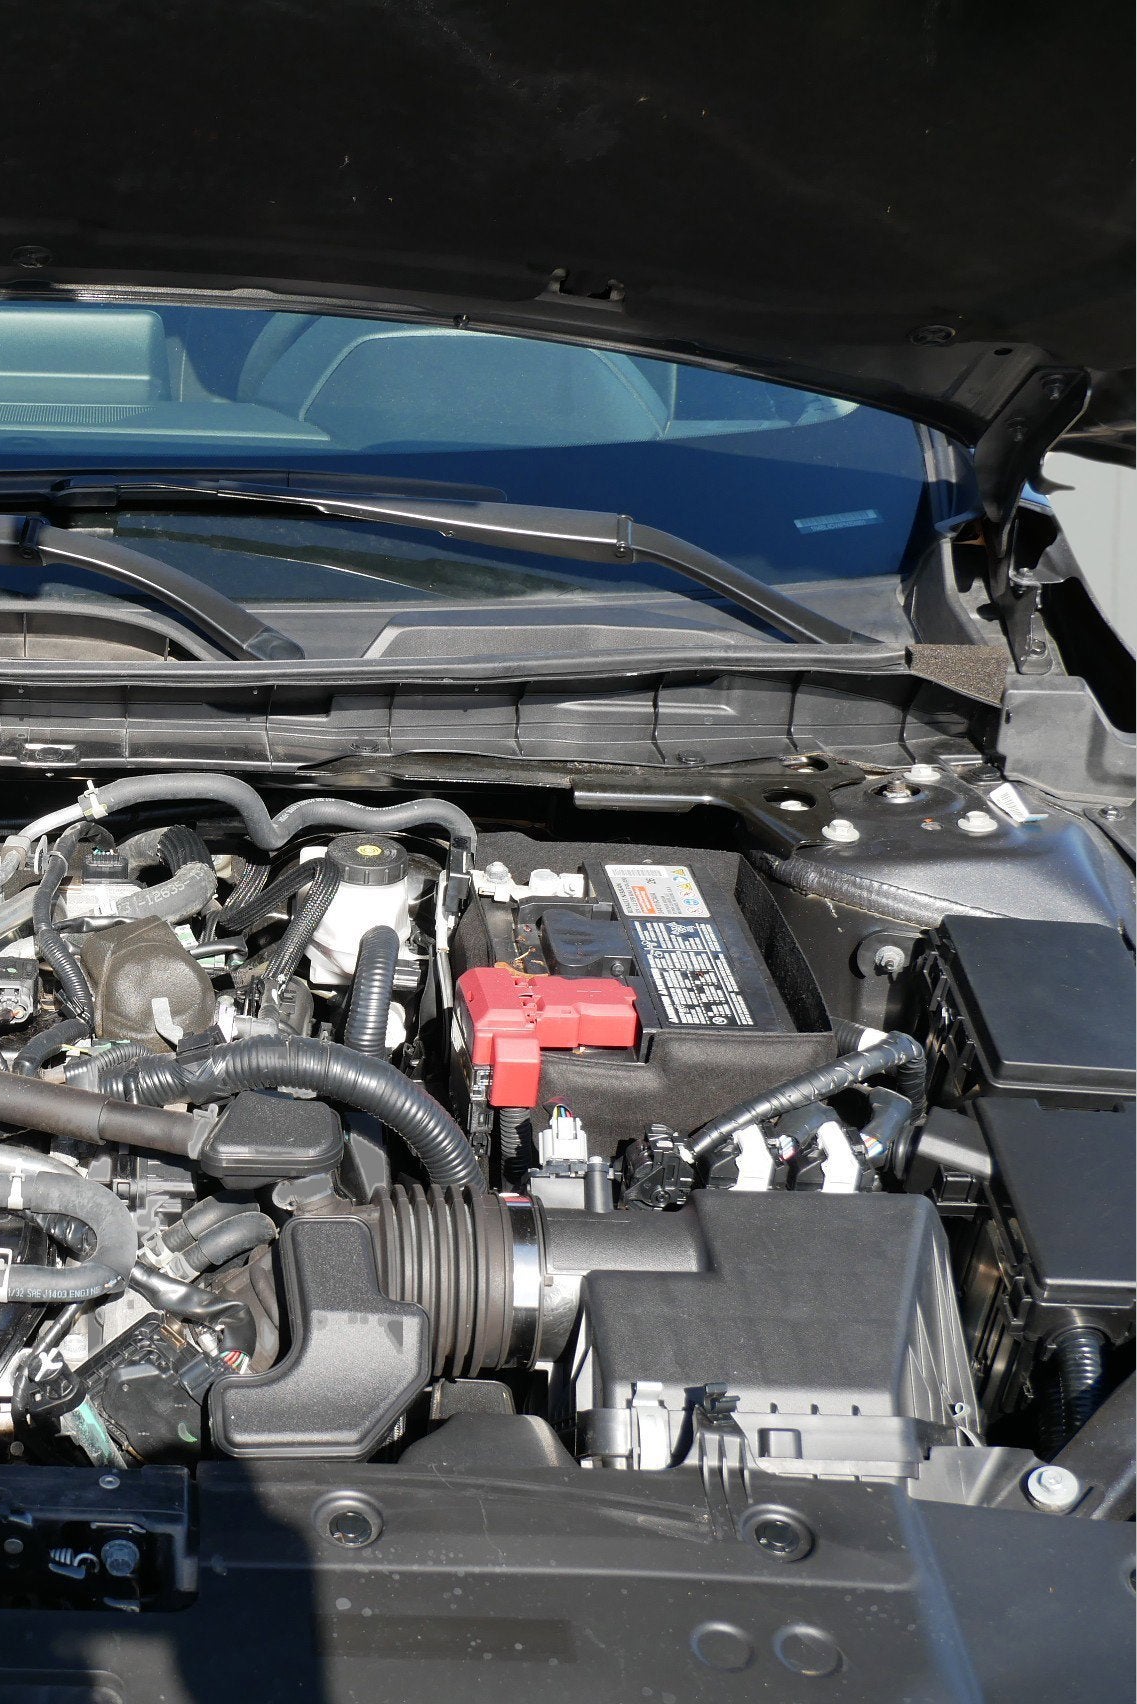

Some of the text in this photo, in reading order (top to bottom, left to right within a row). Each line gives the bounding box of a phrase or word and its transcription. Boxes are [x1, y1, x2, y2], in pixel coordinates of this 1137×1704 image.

[26, 1288, 41, 1298] SAE
[42, 1289, 67, 1299] J1403
[69, 1285, 101, 1299] ENGINE
